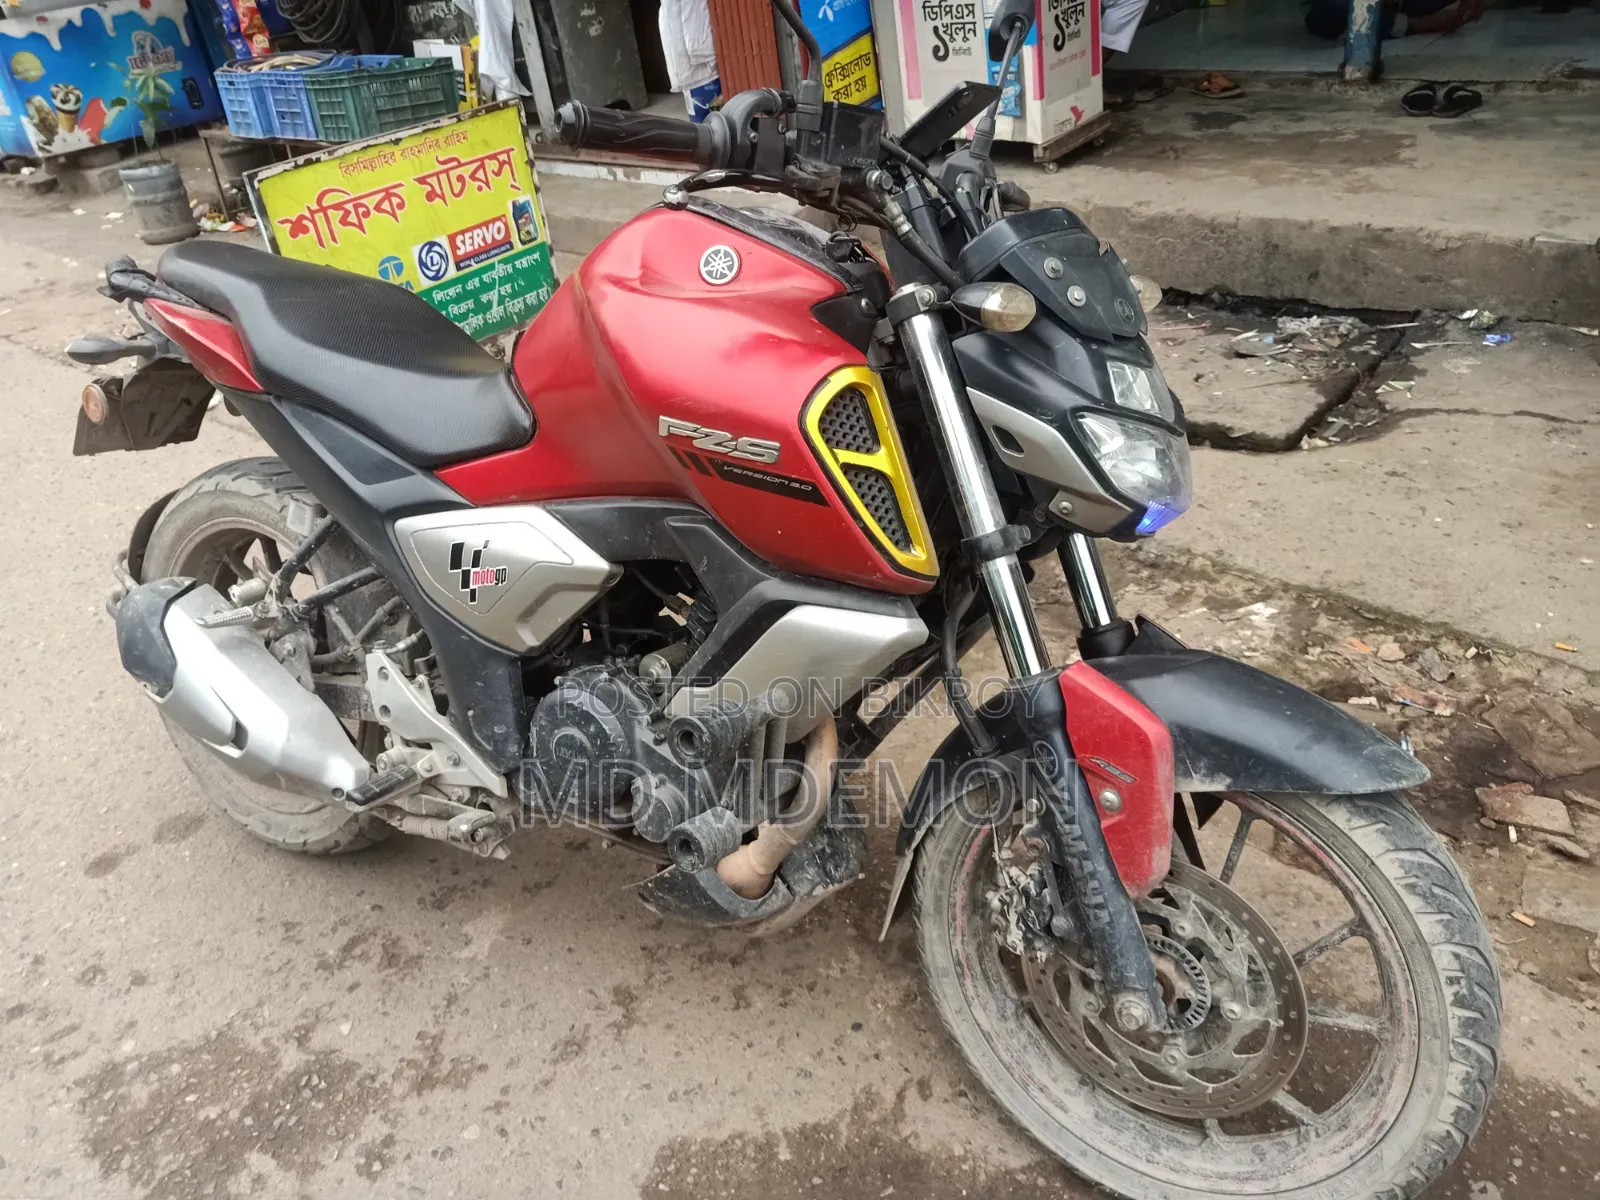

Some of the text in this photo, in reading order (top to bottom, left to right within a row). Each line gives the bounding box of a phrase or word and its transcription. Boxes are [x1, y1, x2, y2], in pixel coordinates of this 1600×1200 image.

[922, 0, 975, 21] ডিপিএস
[1061, 1, 1085, 29] খুলুন
[932, 25, 949, 62] ১
[941, 21, 977, 43] খুলুন
[1053, 13, 1066, 52] ১
[831, 75, 867, 101] করা হয়
[338, 129, 469, 178] বিসমিল্লাহির রাহমানির রাহিম
[277, 147, 522, 249] শফিক মটরস্
[455, 220, 506, 256] SERVO
[465, 276, 480, 291] এর
[723, 465, 790, 485] VERSION
[471, 567, 507, 586] motogp
